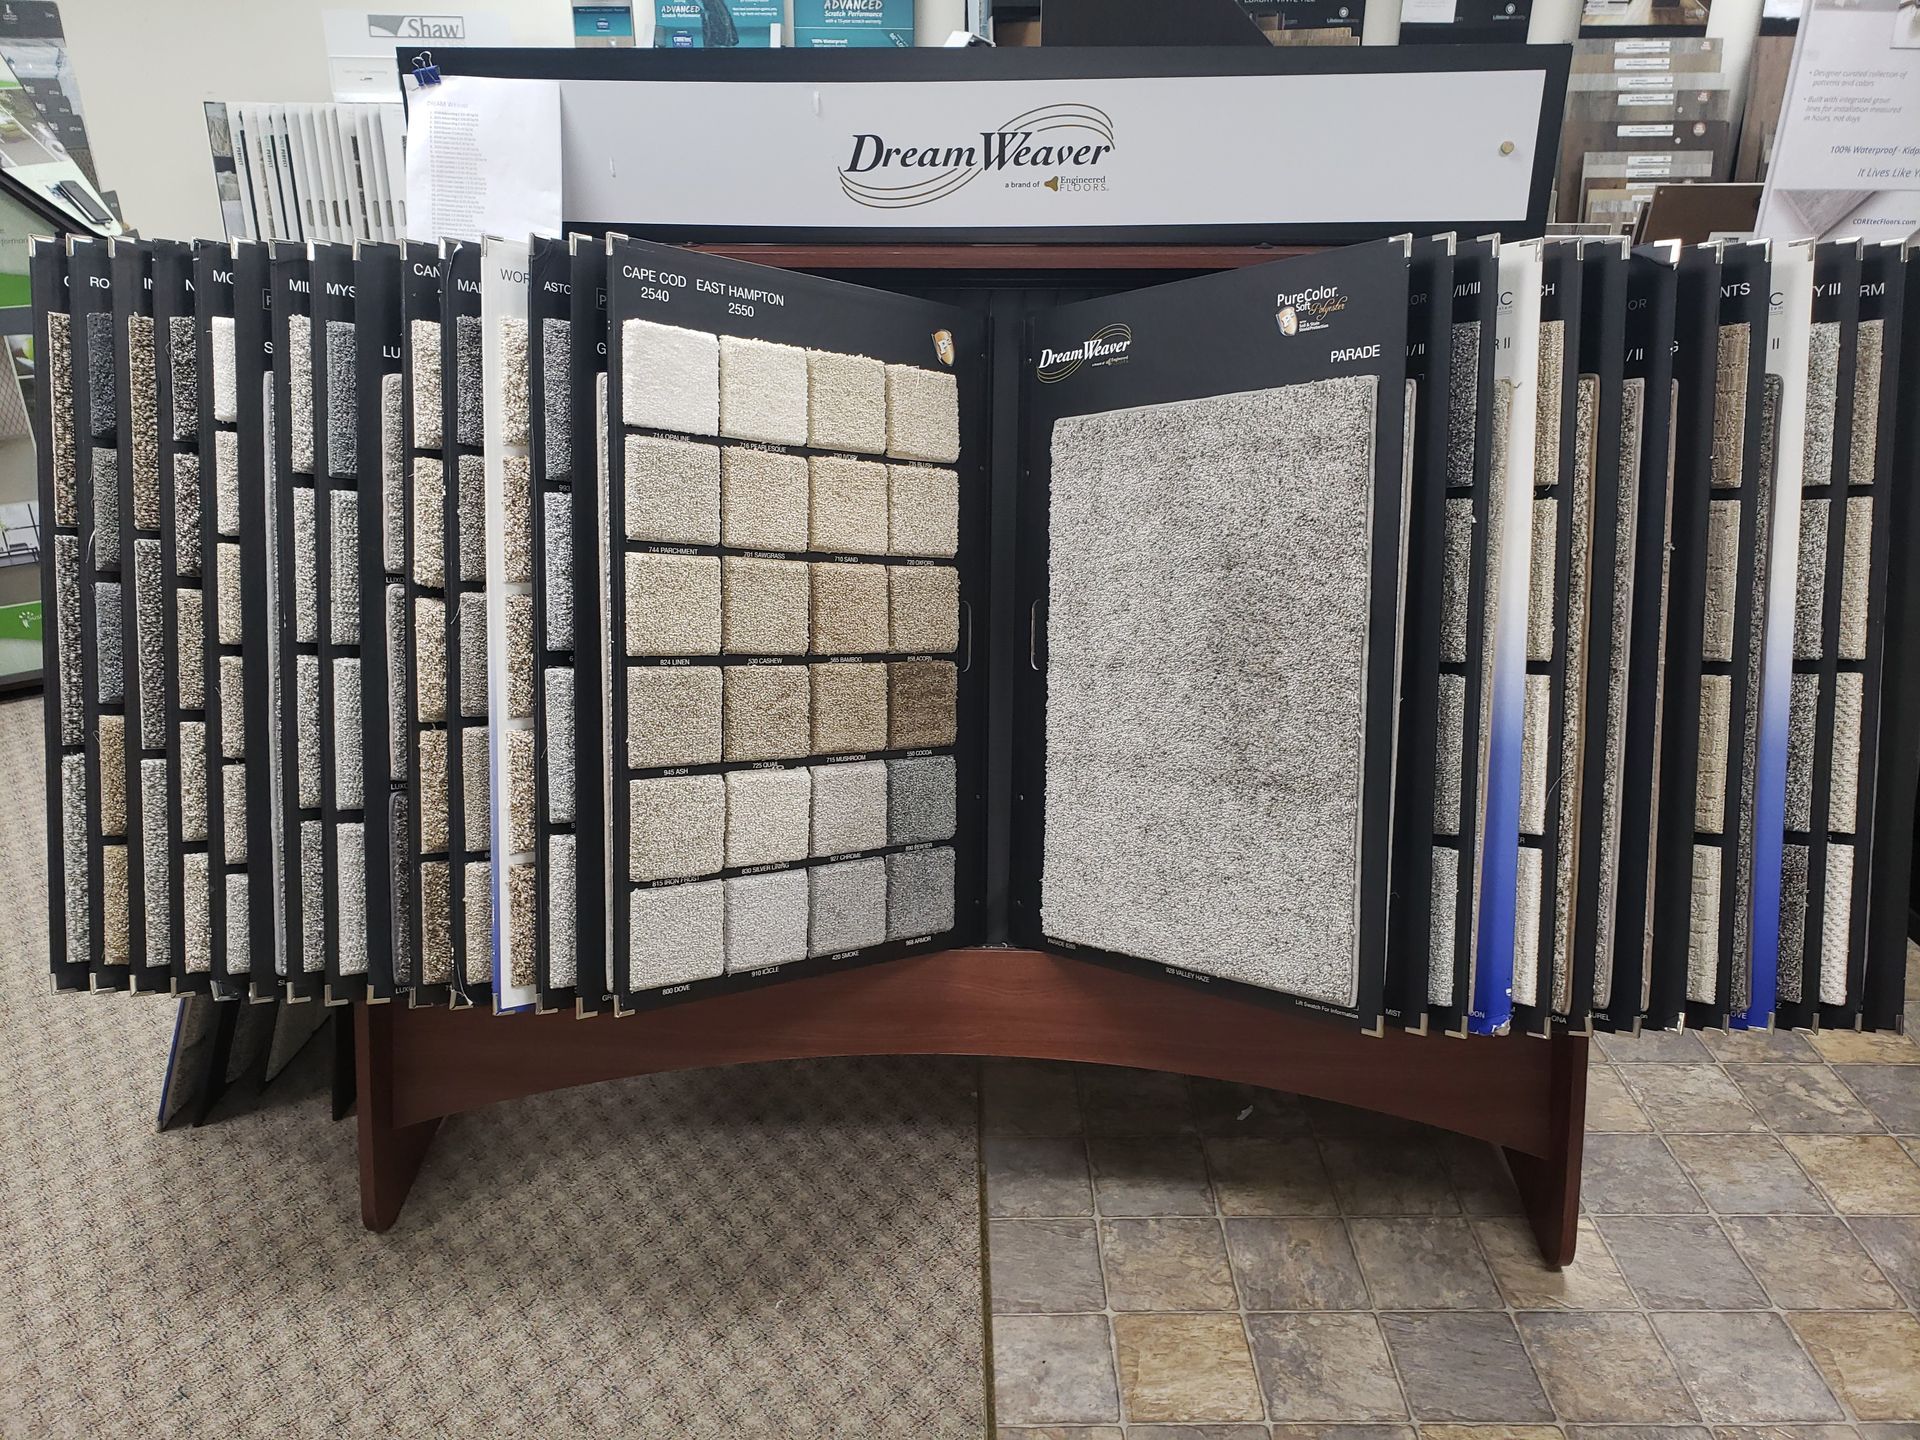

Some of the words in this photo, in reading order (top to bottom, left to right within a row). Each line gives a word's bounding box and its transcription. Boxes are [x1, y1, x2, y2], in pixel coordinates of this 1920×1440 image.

[824, 0, 883, 10] ADVANCED
[407, 18, 459, 38] Shaw
[1855, 79, 1875, 87] colors
[1869, 105, 1902, 114] measured
[1833, 114, 1845, 122] not
[1830, 145, 1850, 154] 100%
[1852, 146, 1898, 156] Waterproof
[1857, 168, 1865, 178] It
[1866, 168, 1890, 178] Lives
[1892, 168, 1912, 178] Like
[1010, 180, 1031, 189] brand
[1032, 180, 1041, 189] of
[1060, 175, 1106, 187] Engineered
[1852, 217, 1917, 226] COREtecFloors.com
[622, 265, 657, 283] CAPE
[659, 272, 687, 288] COD
[640, 286, 670, 303] 2540
[696, 279, 726, 296] EAST
[728, 285, 785, 307] HAMPTON
[1409, 293, 1428, 306] OR
[728, 302, 755, 318] 2550
[1295, 301, 1311, 312] Soft
[1308, 296, 1348, 320] Polyester
[1330, 344, 1381, 363] PARADE
[648, 546, 660, 554] 744
[660, 547, 698, 556] PARCHMENT
[754, 552, 786, 560] SAWGRASS
[660, 659, 671, 667] 824
[836, 754, 866, 763] MUSHROOM
[663, 769, 674, 777] 945
[675, 768, 689, 776] ASH
[913, 843, 933, 851] PEWTER
[840, 853, 862, 862] CHROME
[741, 868, 752, 876] 830
[752, 865, 771, 875] SILVER
[652, 880, 663, 888] 815
[664, 878, 680, 887] IRON
[914, 936, 932, 946] ARMOR
[841, 950, 860, 961] SMOKE
[751, 970, 761, 979] 910
[762, 966, 780, 977] ICICLE
[1175, 968, 1195, 980] VALLEY
[1195, 973, 1210, 984] HAZE
[662, 988, 674, 997] 800
[674, 984, 690, 995] DOVE
[1304, 1001, 1321, 1011] Swatch
[1330, 1007, 1359, 1019] Information
[1385, 1008, 1401, 1018] MIST
[1730, 1010, 1748, 1020] OVE
[1551, 1015, 1567, 1025] ONA
